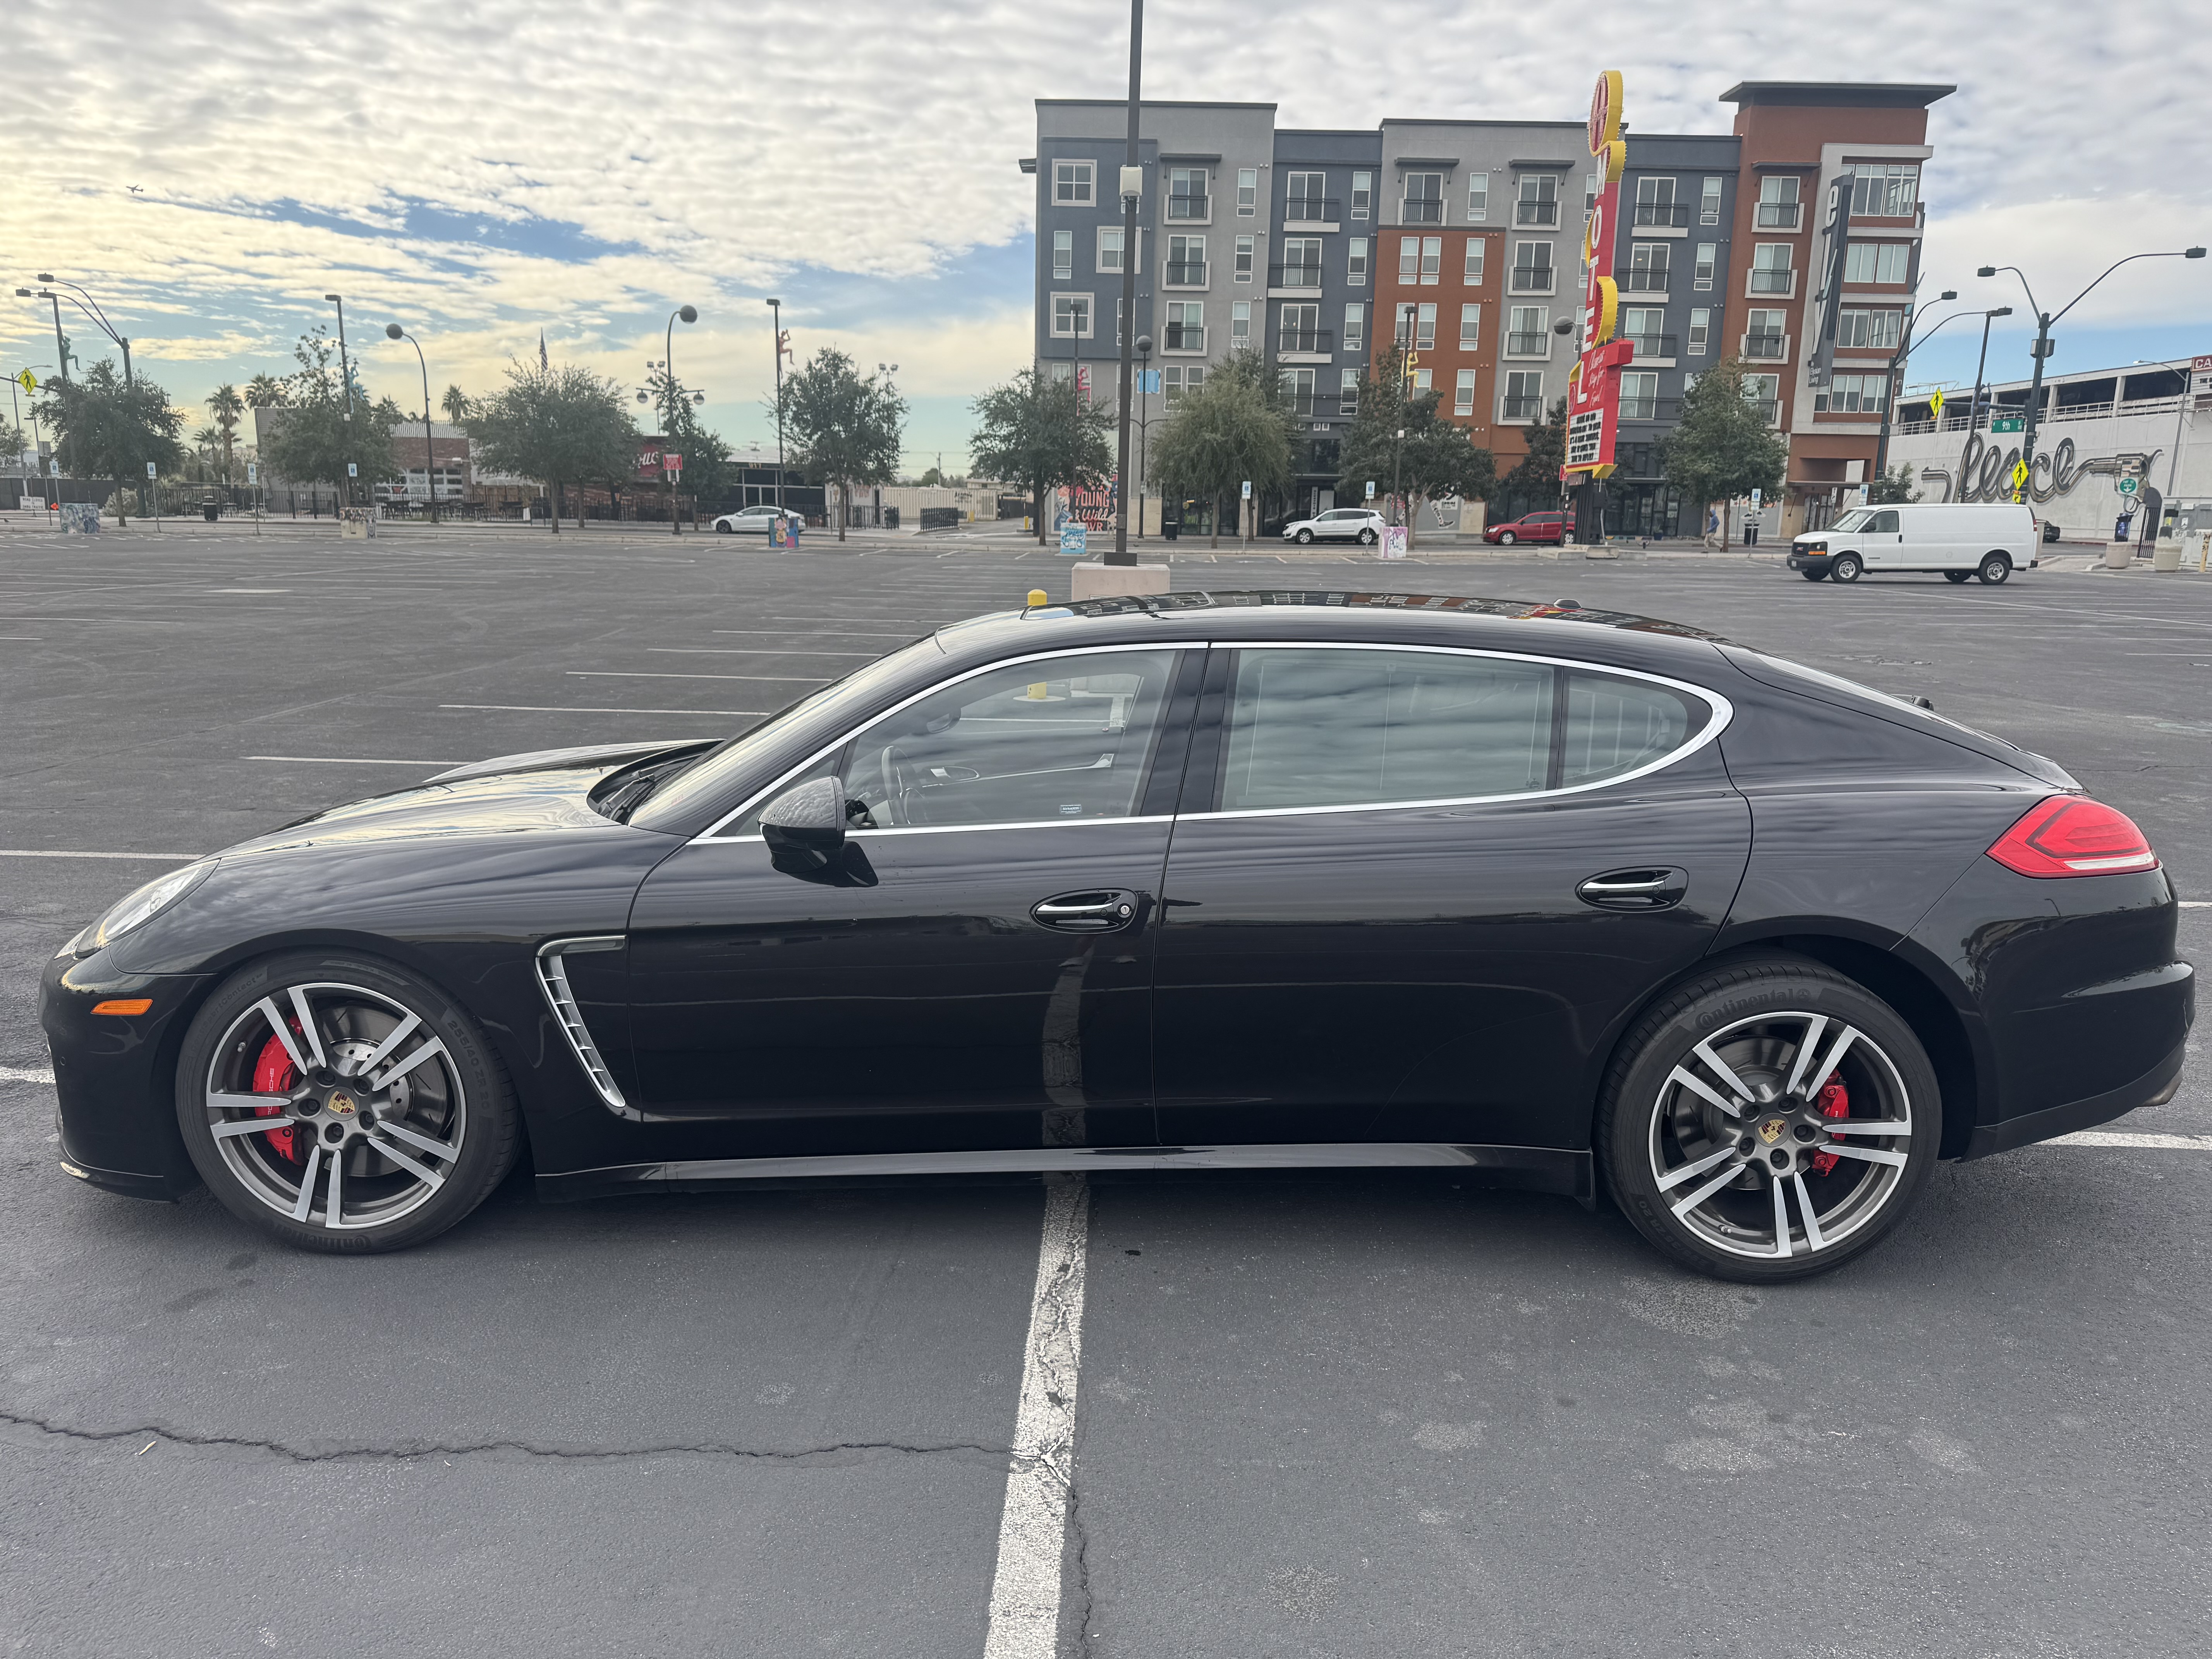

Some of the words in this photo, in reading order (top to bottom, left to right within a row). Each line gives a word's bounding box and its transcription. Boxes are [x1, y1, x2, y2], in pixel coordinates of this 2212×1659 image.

[1577, 148, 1608, 404] MOTEL
[1810, 367, 1821, 376] Elysian
[1809, 376, 1819, 384] Living
[2002, 421, 2010, 430] 9th
[1075, 491, 1110, 507] YOUNG
[1082, 508, 1109, 521] Wild
[1695, 988, 1794, 1030] Continental
[447, 1020, 479, 1066] 255/40
[475, 1069, 487, 1087] ZR
[480, 1091, 489, 1109] 20
[1638, 1201, 1653, 1217] 20
